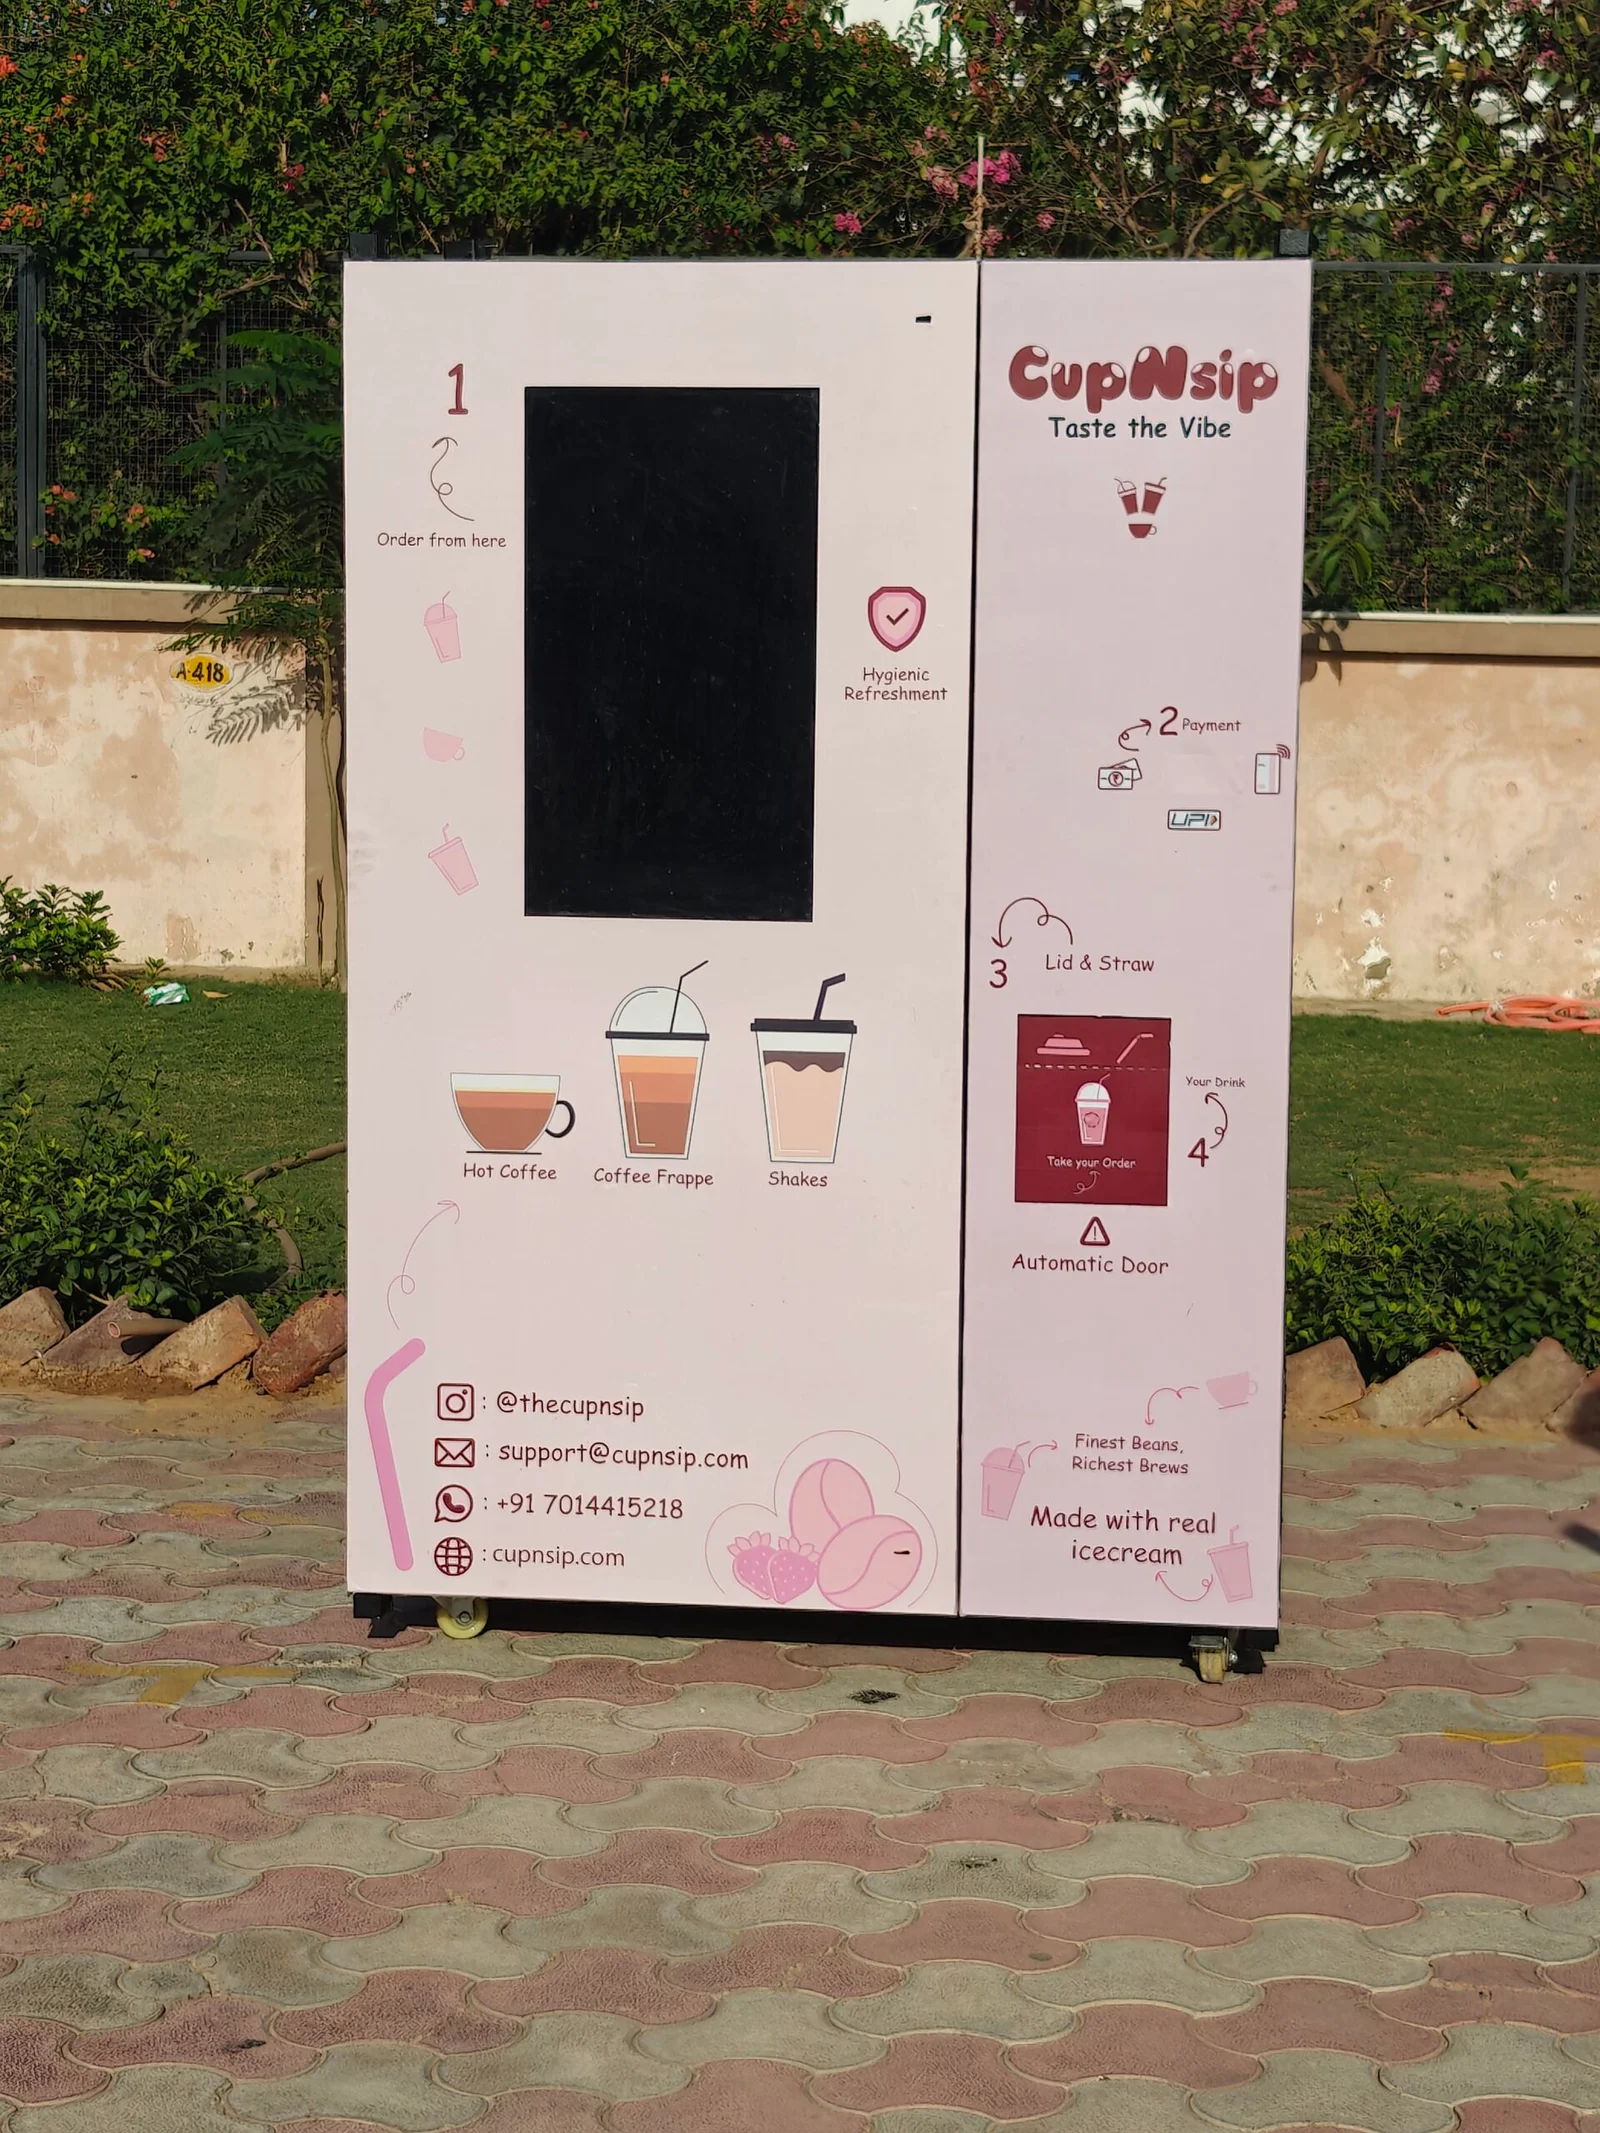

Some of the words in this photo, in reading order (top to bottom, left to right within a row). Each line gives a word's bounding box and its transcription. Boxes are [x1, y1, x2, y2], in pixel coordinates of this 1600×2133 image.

[448, 364, 468, 415] 1
[1048, 417, 1116, 438] Taste
[1128, 416, 1167, 438] the
[1180, 416, 1231, 438] Vibe
[378, 532, 424, 546] Order
[429, 532, 466, 547] from
[472, 533, 506, 547] here
[863, 667, 929, 685] Hygienic
[845, 686, 947, 701] Refreshment
[1160, 706, 1178, 736] 2
[1183, 718, 1241, 734] Payment
[1170, 812, 1210, 827] UPI
[1046, 954, 1072, 970] Lid
[1080, 954, 1091, 970] &
[1099, 956, 1154, 971] Straw
[990, 959, 1007, 988] 3
[1186, 1076, 1211, 1086] Your
[1216, 1077, 1245, 1087] Drink
[1047, 1156, 1072, 1166] Take
[1076, 1159, 1099, 1169] your
[1102, 1157, 1135, 1168] Order
[1188, 1138, 1208, 1167] 4
[464, 1163, 494, 1178] Hot
[500, 1164, 557, 1180] Coffee
[594, 1168, 651, 1183] Coffee
[658, 1169, 713, 1189] Frappe
[769, 1171, 827, 1187] Shakes
[1012, 1254, 1113, 1272] Automatic
[1122, 1256, 1168, 1274] Door
[497, 1391, 643, 1421] @thecupnsip
[1076, 1433, 1125, 1449] Finest
[1132, 1436, 1183, 1453] Beans,
[499, 1442, 748, 1472] support@cupnsip.com
[1073, 1456, 1132, 1472] Richest
[1140, 1458, 1188, 1474] Brews
[498, 1493, 534, 1513] +91
[544, 1495, 682, 1519] 7014415218
[1031, 1506, 1097, 1528] Made
[1106, 1509, 1158, 1531] with
[1170, 1512, 1215, 1533] real
[493, 1546, 624, 1569] cupnsip.com
[1073, 1540, 1182, 1565] icecream
